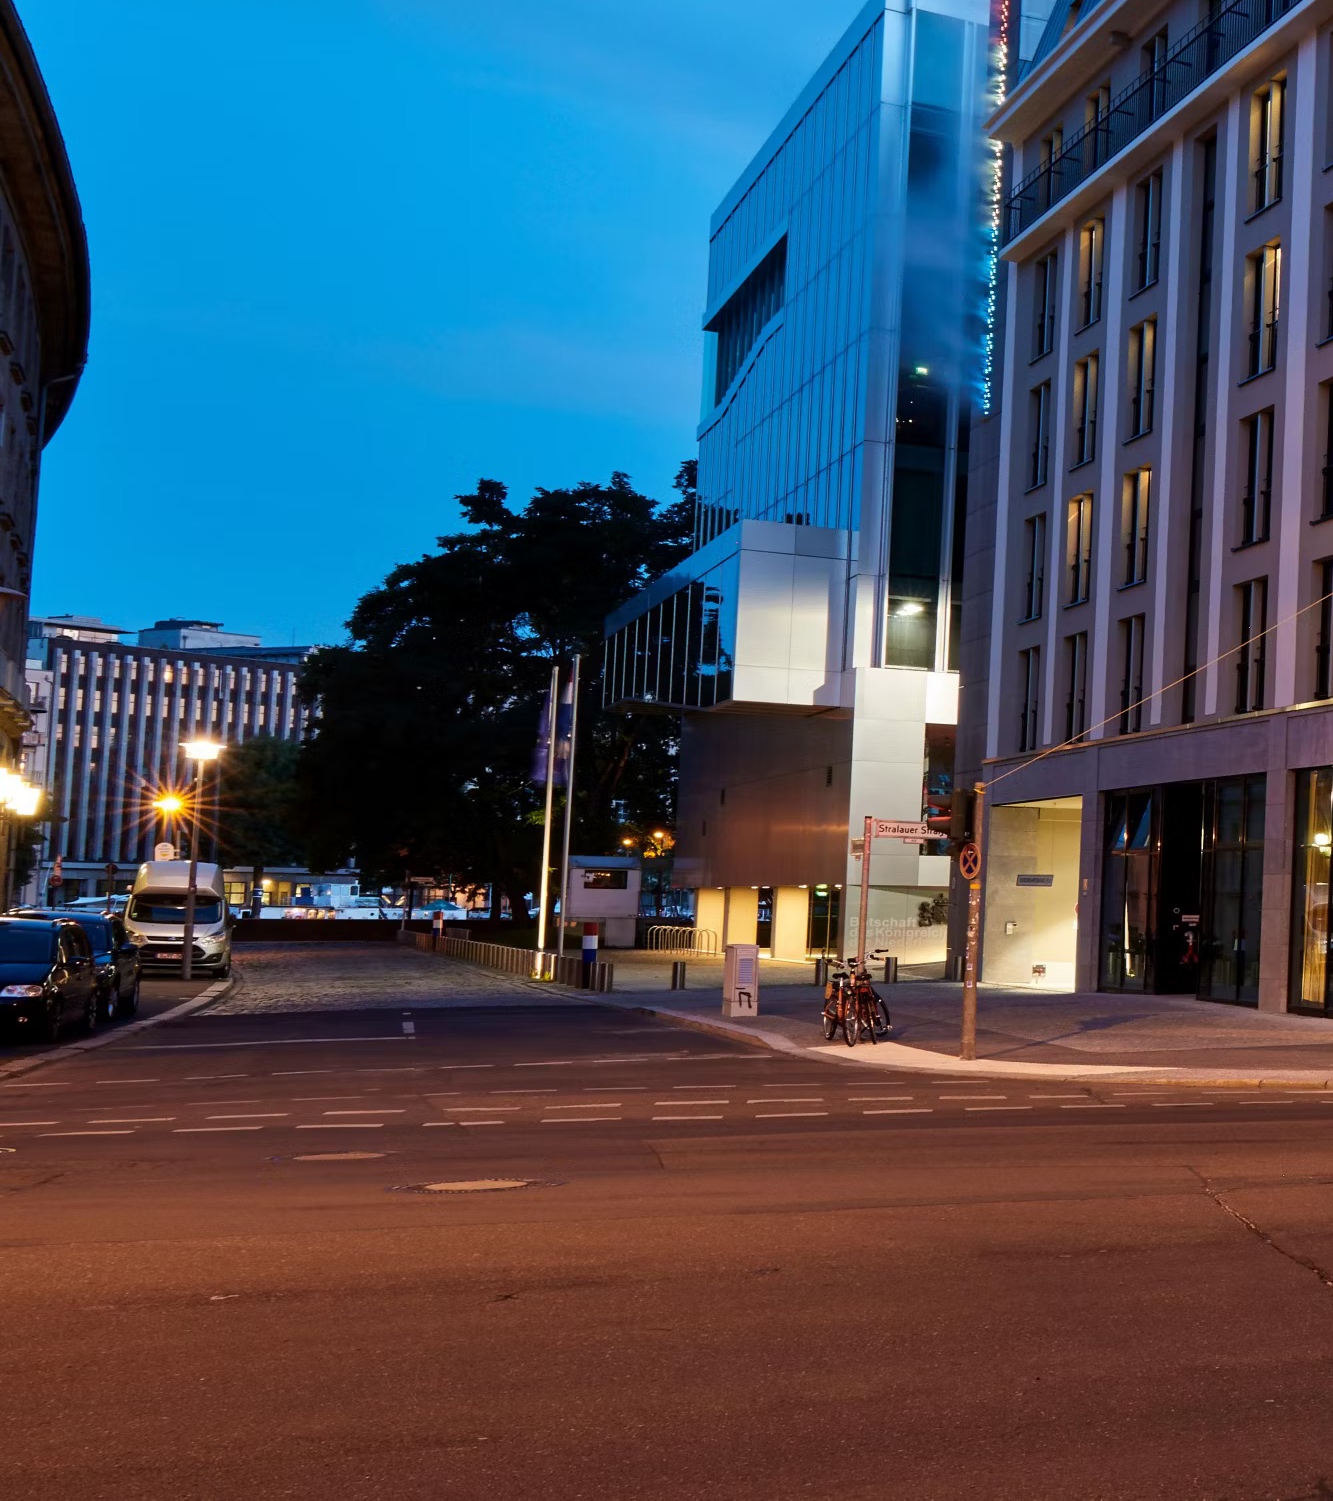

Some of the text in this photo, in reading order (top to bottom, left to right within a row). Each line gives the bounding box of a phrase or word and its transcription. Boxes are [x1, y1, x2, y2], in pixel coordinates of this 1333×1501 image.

[879, 824, 918, 834] Stralauer
[849, 916, 918, 928] Btschaft
[849, 927, 873, 938] ds
[849, 938, 872, 948] dr
